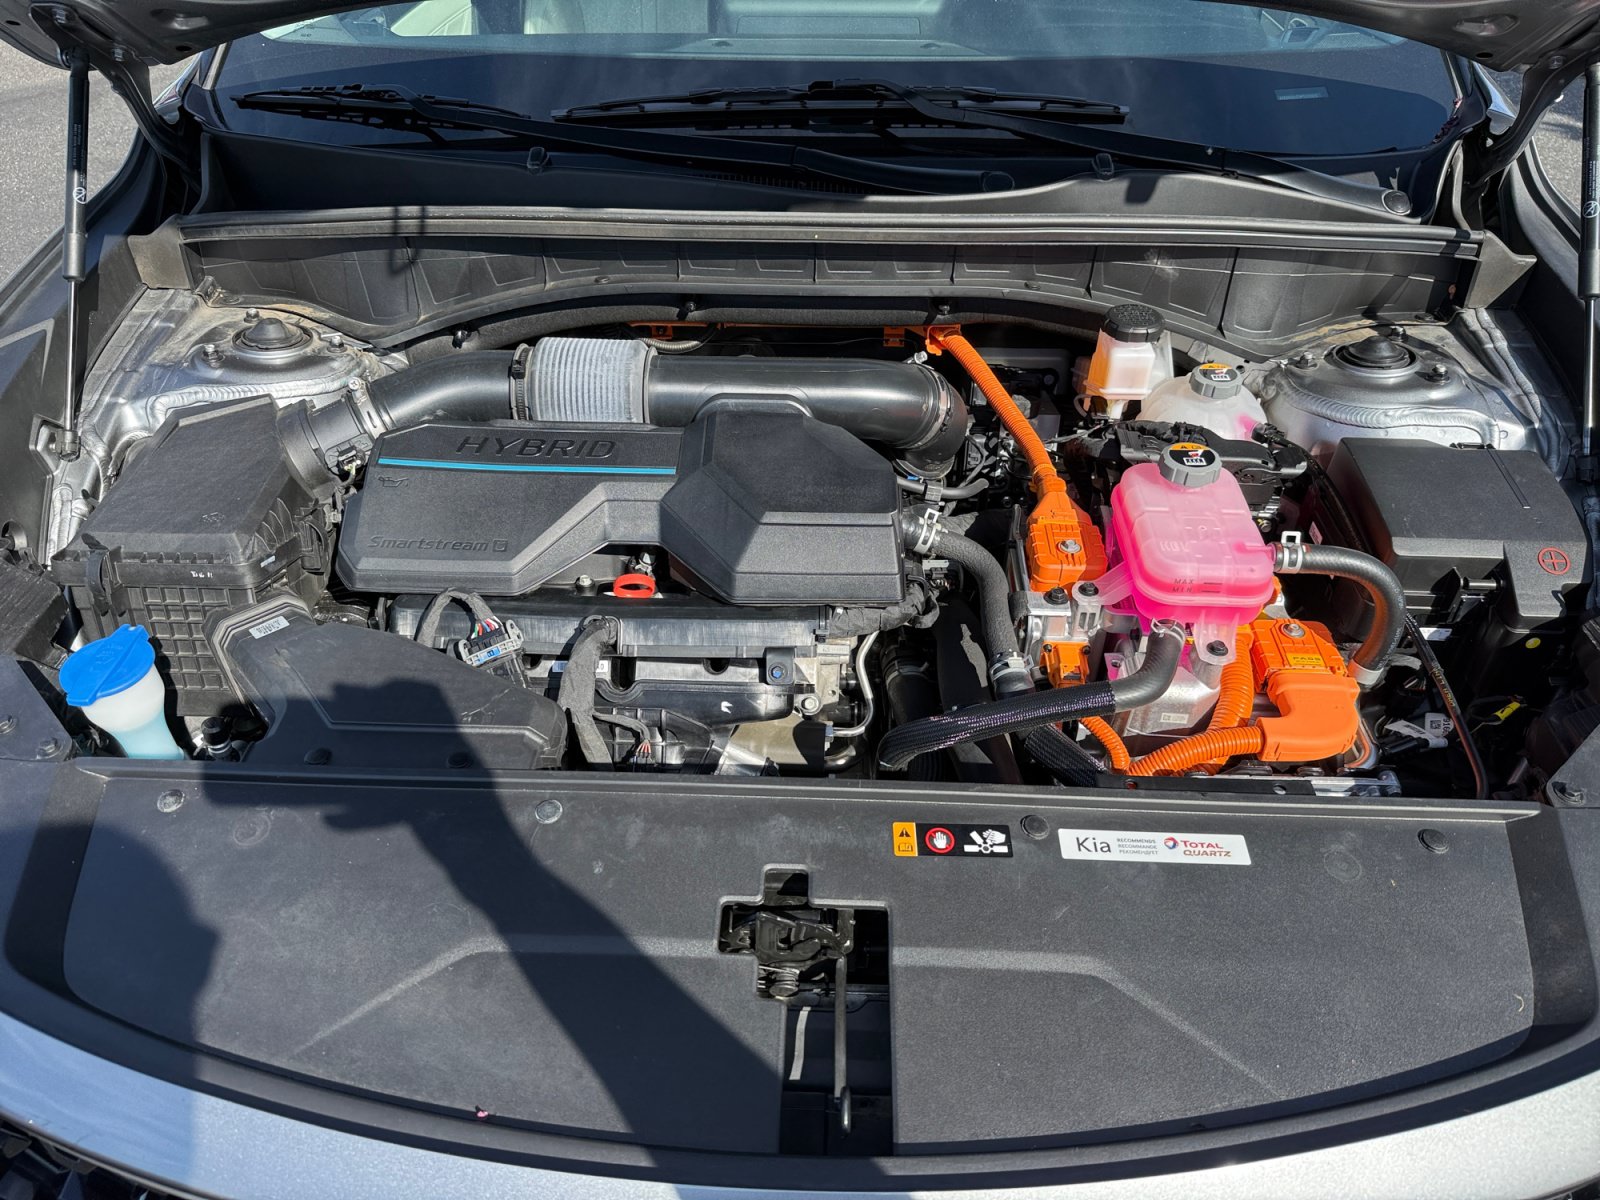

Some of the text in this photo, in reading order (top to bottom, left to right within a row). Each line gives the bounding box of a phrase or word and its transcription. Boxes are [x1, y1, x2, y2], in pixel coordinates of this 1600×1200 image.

[456, 435, 617, 459] HYBRID
[367, 534, 490, 552] Smartstream
[1075, 836, 1112, 853] Kia
[1180, 839, 1224, 850] TOTAL
[1183, 849, 1232, 857] QUARTZ
